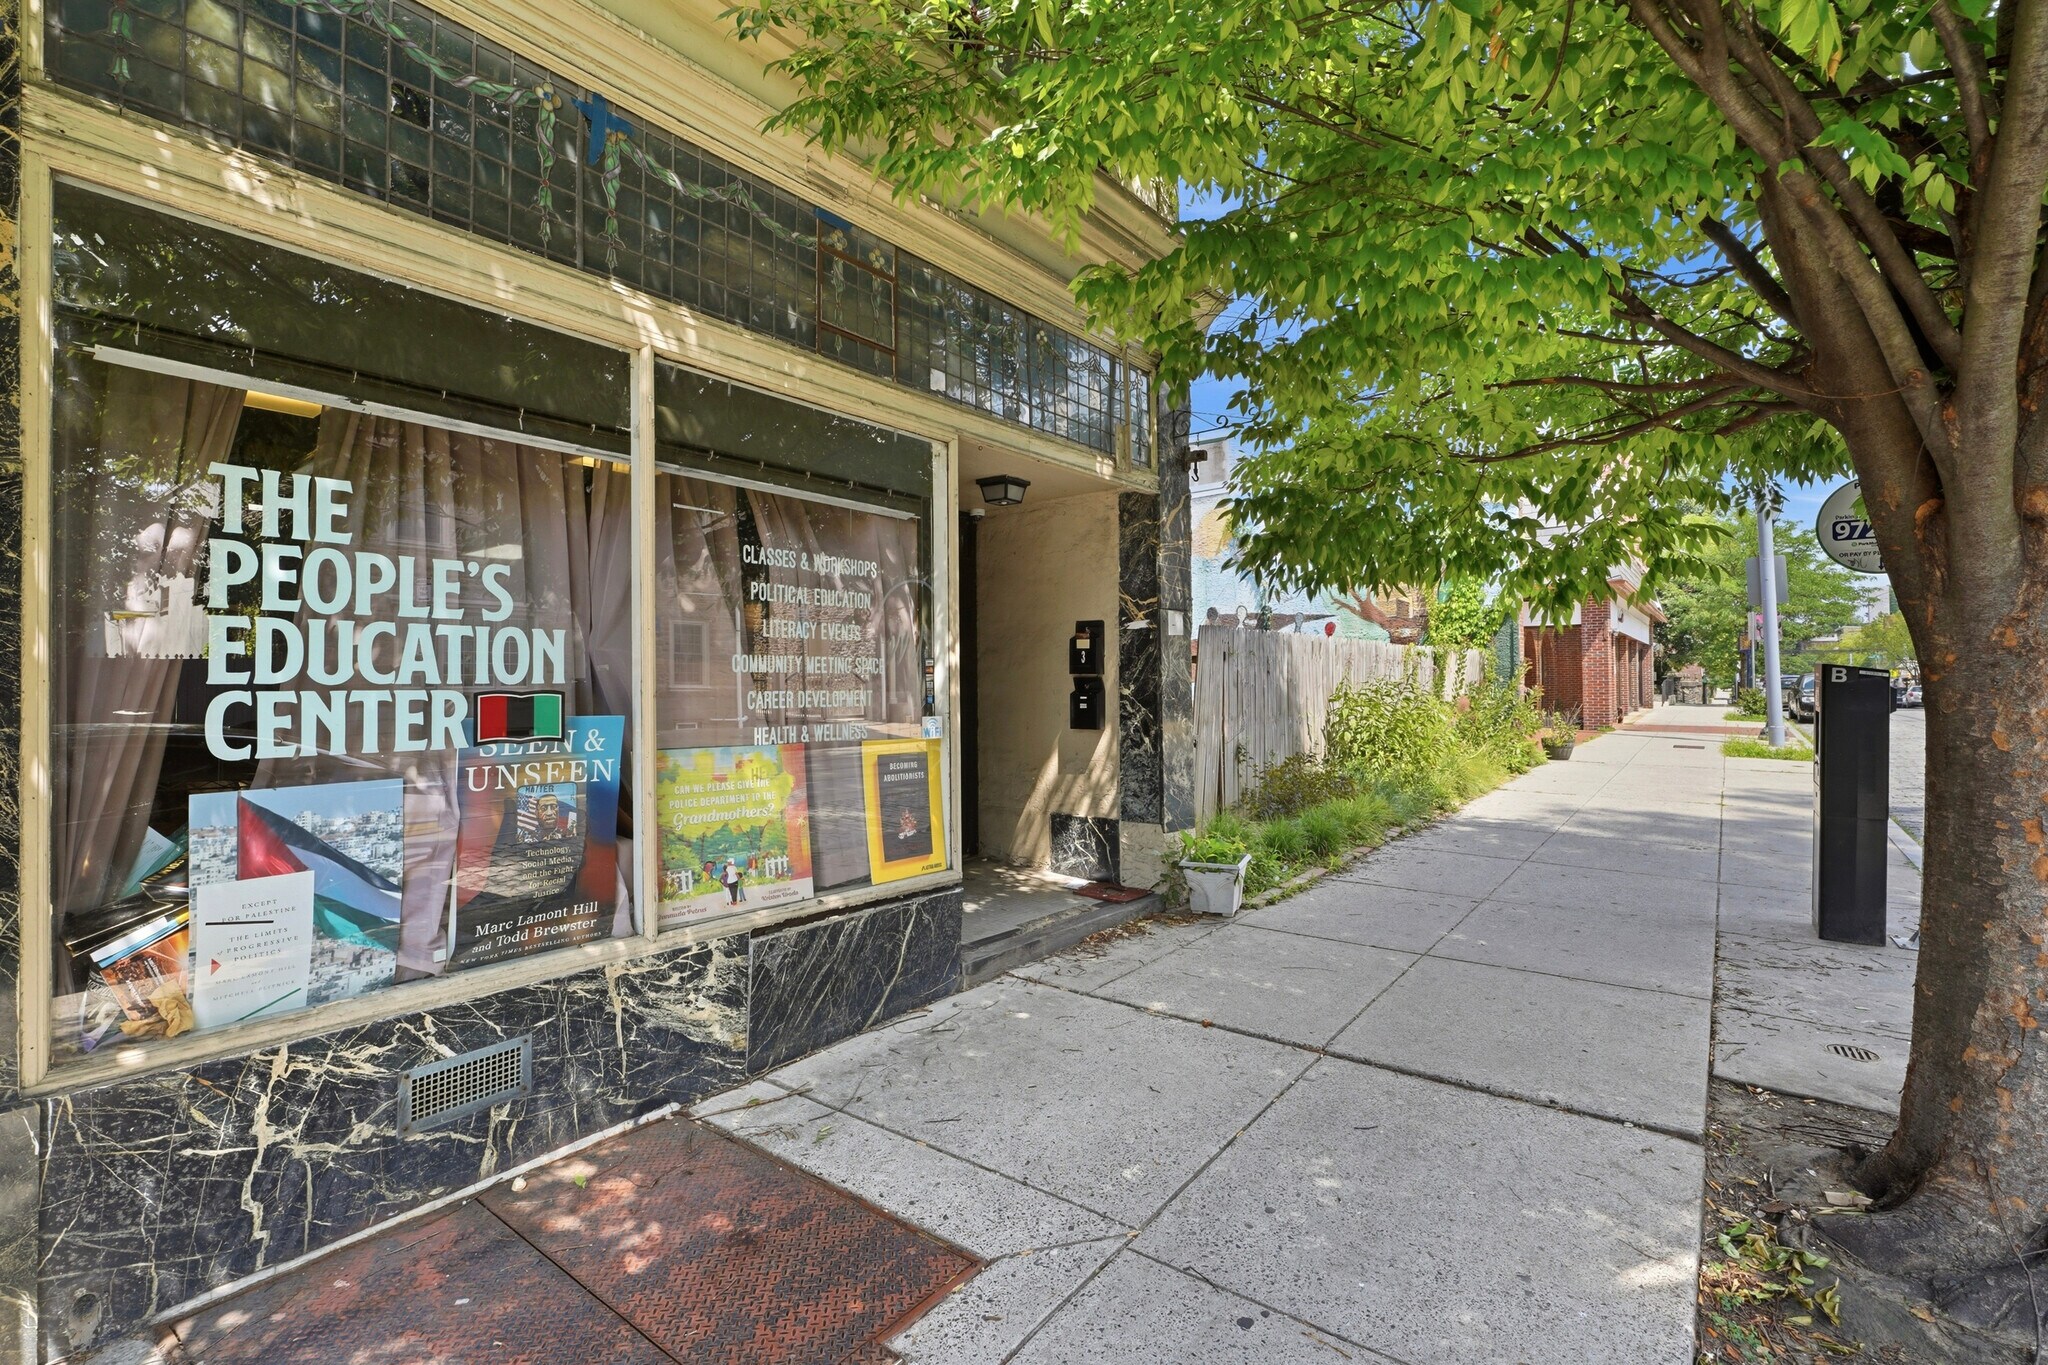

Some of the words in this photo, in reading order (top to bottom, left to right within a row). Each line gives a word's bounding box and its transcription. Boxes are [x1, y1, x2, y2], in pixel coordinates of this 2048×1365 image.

[209, 462, 354, 545] THE
[743, 544, 797, 569] CLASSES
[800, 552, 809, 570] &
[812, 553, 877, 579] WORKSHOPS
[750, 581, 809, 605] POLITICAL
[814, 588, 871, 609] EDUCATION
[763, 618, 817, 640] LITERACY
[821, 622, 861, 641] EVENTS
[206, 615, 567, 686] EDUCATION
[1080, 650, 1086, 663] 3
[732, 654, 802, 673] COMMUNITY
[806, 656, 853, 674] MEETING
[855, 657, 885, 675] SPACE
[1831, 667, 1848, 683] B
[747, 690, 794, 710] CAREER
[797, 690, 873, 709] DEVELOPMENT
[204, 690, 469, 761] CENTER
[754, 725, 797, 746] HEALTH
[801, 725, 810, 743] &
[814, 724, 868, 743] WELLNESS
[479, 729, 577, 758] SEEN
[584, 728, 606, 752] &
[465, 758, 615, 792] UNSEEN
[889, 761, 918, 770] BECOMING
[674, 785, 690, 795] CAN
[693, 783, 705, 793] WE
[707, 781, 735, 792] PLEASE
[737, 780, 754, 790] GIVE
[757, 777, 770, 787] THE
[883, 771, 925, 783] ABOLITIONISTS
[669, 798, 698, 810] POLICE
[700, 793, 749, 807] DEPARTMENT
[763, 791, 776, 800] THE
[673, 802, 775, 831] Grandmothers?
[526, 846, 571, 857] Technology,
[522, 859, 547, 869] Social
[549, 855, 574, 866] Media,
[539, 869, 552, 877] the
[554, 865, 573, 876] Fight
[542, 876, 566, 886] Racial
[241, 899, 278, 910] EXCEPT
[245, 906, 297, 919] PALESTINE
[475, 920, 513, 937] Marc
[517, 907, 568, 927] Lamont
[573, 901, 599, 915] Hill
[226, 935, 299, 954] PROGRESSIVE
[230, 934, 249, 943] THE
[254, 927, 288, 938] LIMITS
[471, 942, 492, 954] and
[496, 929, 529, 948] Todd
[533, 918, 598, 938] Brewster
[234, 948, 281, 962] POLITICS
